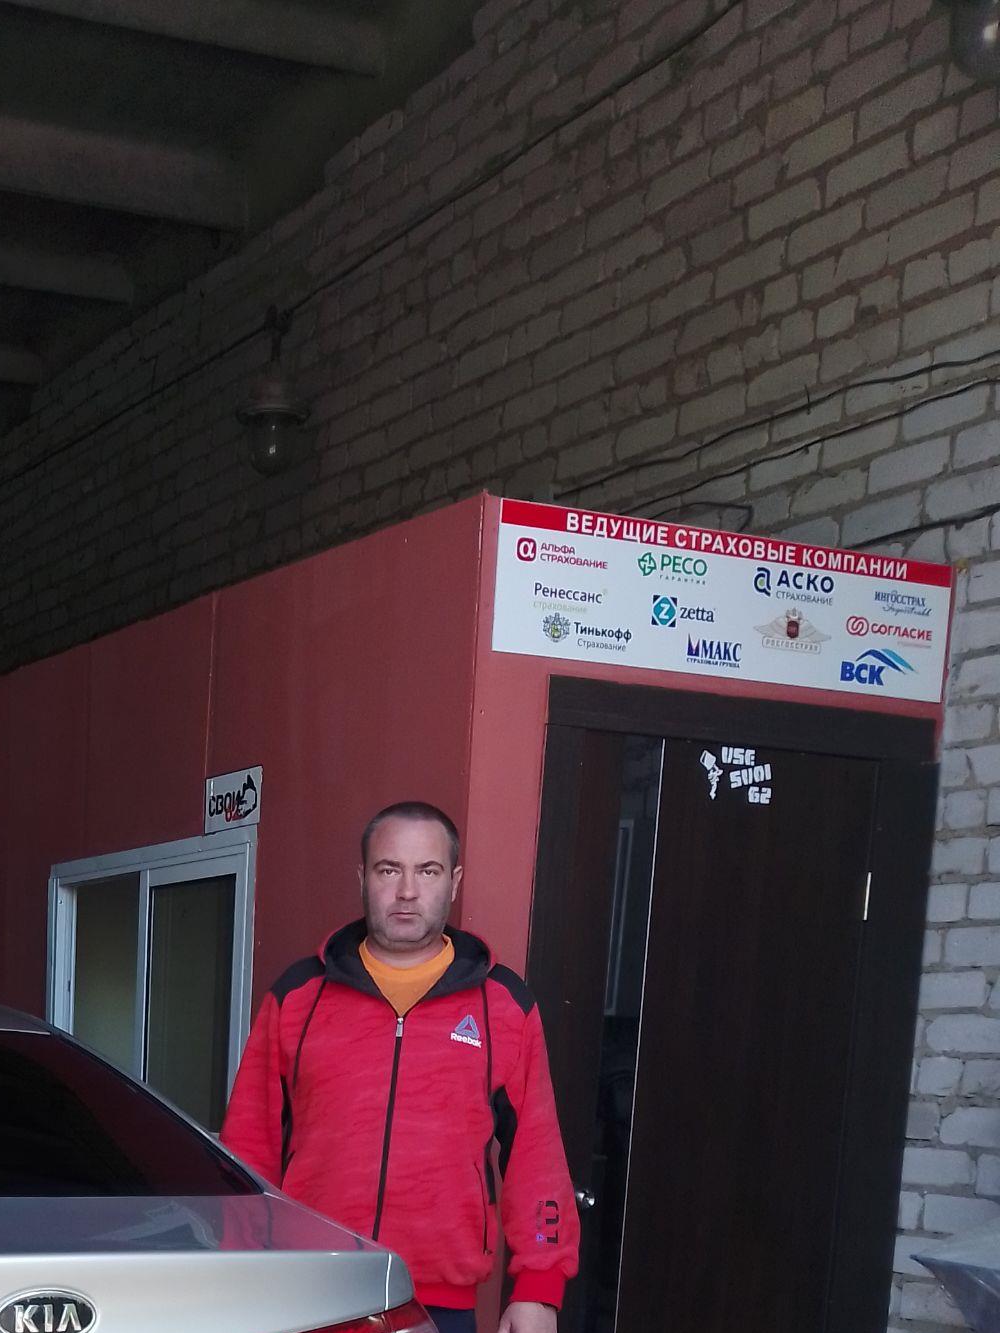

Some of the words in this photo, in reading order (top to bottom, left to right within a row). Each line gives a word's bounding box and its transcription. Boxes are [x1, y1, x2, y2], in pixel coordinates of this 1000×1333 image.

[540, 542, 576, 555] АЛЬФА
[566, 512, 668, 545] ВЕДУЩИЕ
[674, 529, 796, 563] СТРАХОВЫЕ
[802, 548, 908, 580] КОМПАНИИ
[540, 553, 608, 569] СТРАХОВАНИЕ
[660, 554, 708, 577] РЕСО
[777, 570, 834, 594] АСКО
[534, 582, 603, 604] Ренессанс
[776, 590, 833, 606] СТРАХОВАНИЕ
[680, 606, 714, 622] zetta
[574, 621, 632, 644] Тинькофф
[871, 623, 933, 641] СОГЛАСИЕ
[577, 638, 626, 652] Страхование
[840, 661, 886, 686] ВСК
[450, 1032, 482, 1048] Reebok
[13, 1302, 82, 1333] KIA
